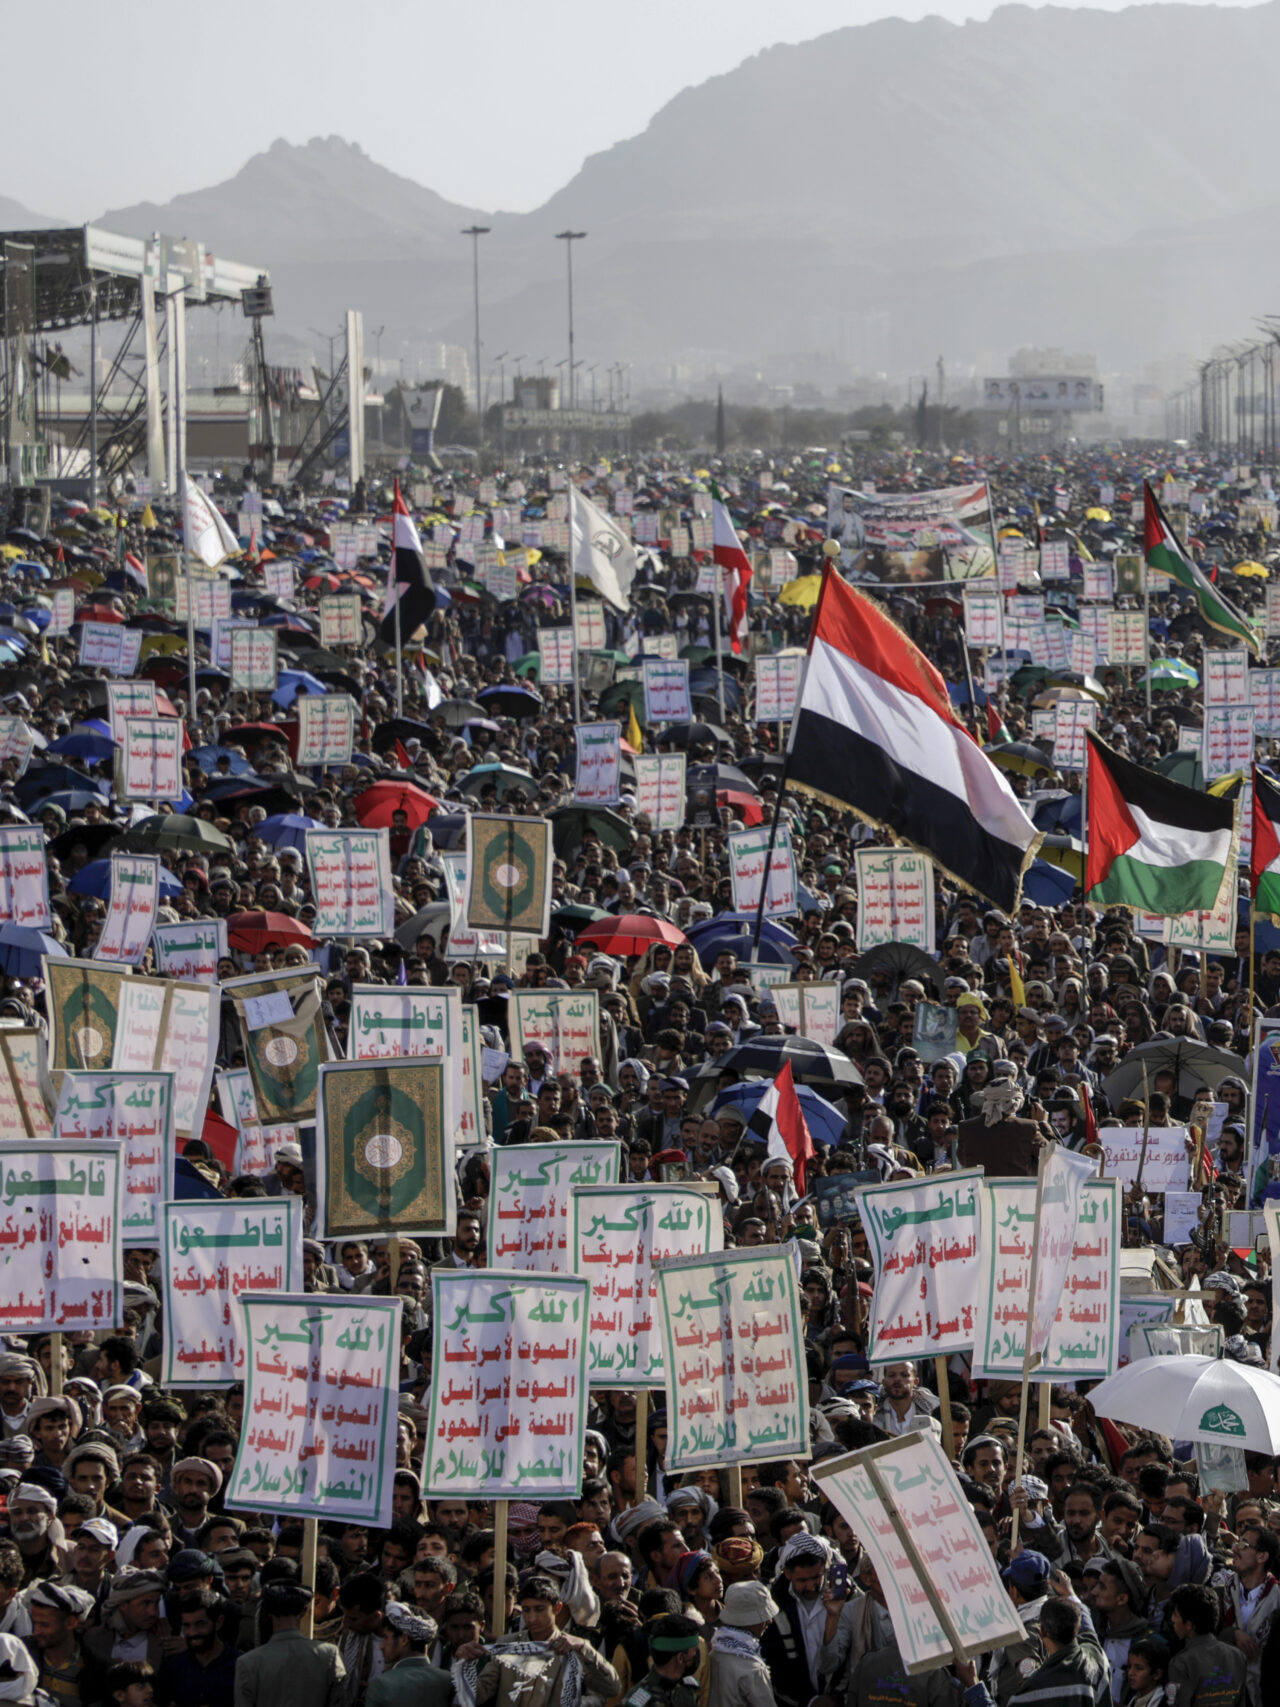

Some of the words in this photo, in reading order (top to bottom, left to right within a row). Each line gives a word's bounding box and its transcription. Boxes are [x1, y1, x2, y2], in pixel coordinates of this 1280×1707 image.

[61, 1078, 123, 1118] أكبر
[125, 1083, 164, 1108] الله
[60, 1116, 113, 1138] لأمريكا
[117, 1119, 162, 1140] الموت
[499, 1152, 568, 1197] أكبر
[569, 1158, 611, 1184] الله
[580, 1195, 656, 1240] أكبر
[658, 1202, 703, 1231] الله
[871, 1186, 976, 1242] قاطعوا
[59, 1211, 111, 1248] البضائع
[173, 1218, 283, 1256] قاطعوا
[46, 1251, 54, 1278] و
[883, 1239, 927, 1278] الأمريكية
[930, 1236, 976, 1269] البضائع
[174, 1262, 229, 1296] الأمريكية
[233, 1265, 282, 1295] البضائع
[743, 1270, 786, 1302] الله
[920, 1276, 927, 1299] و
[445, 1284, 526, 1335] أكبر
[528, 1292, 579, 1323] الله
[671, 1268, 737, 1321] أكبر
[224, 1302, 231, 1324] و
[738, 1312, 790, 1342] الموت
[256, 1310, 333, 1351] أكبر
[336, 1319, 384, 1351] الله
[675, 1314, 733, 1348] لأمريكا
[445, 1333, 512, 1366] لأمريكا
[518, 1338, 576, 1364] الموت
[741, 1349, 792, 1377] الموت
[257, 1352, 320, 1382] لأمريكا
[326, 1368, 381, 1390] الموت
[679, 1354, 736, 1386] لإسرائيل
[254, 1388, 319, 1420] لإسرائيل
[441, 1376, 510, 1406] لإسرائيل
[516, 1376, 575, 1402] الموت
[726, 1387, 749, 1414] على
[756, 1382, 795, 1406] اللعنة
[322, 1403, 378, 1426] الموت
[680, 1392, 720, 1419] اليهود
[438, 1415, 488, 1443] اليهود
[496, 1414, 520, 1442] على
[529, 1411, 574, 1435] اللعنة
[744, 1413, 796, 1446] النصر
[248, 1428, 295, 1453] اليهود
[299, 1436, 325, 1460] على
[332, 1435, 376, 1460] اللعنة
[679, 1422, 736, 1462] للإسلام
[433, 1450, 505, 1489] للإسلام
[512, 1445, 572, 1487] النصر
[236, 1459, 308, 1505] للإسلام
[312, 1464, 373, 1504] النصر
